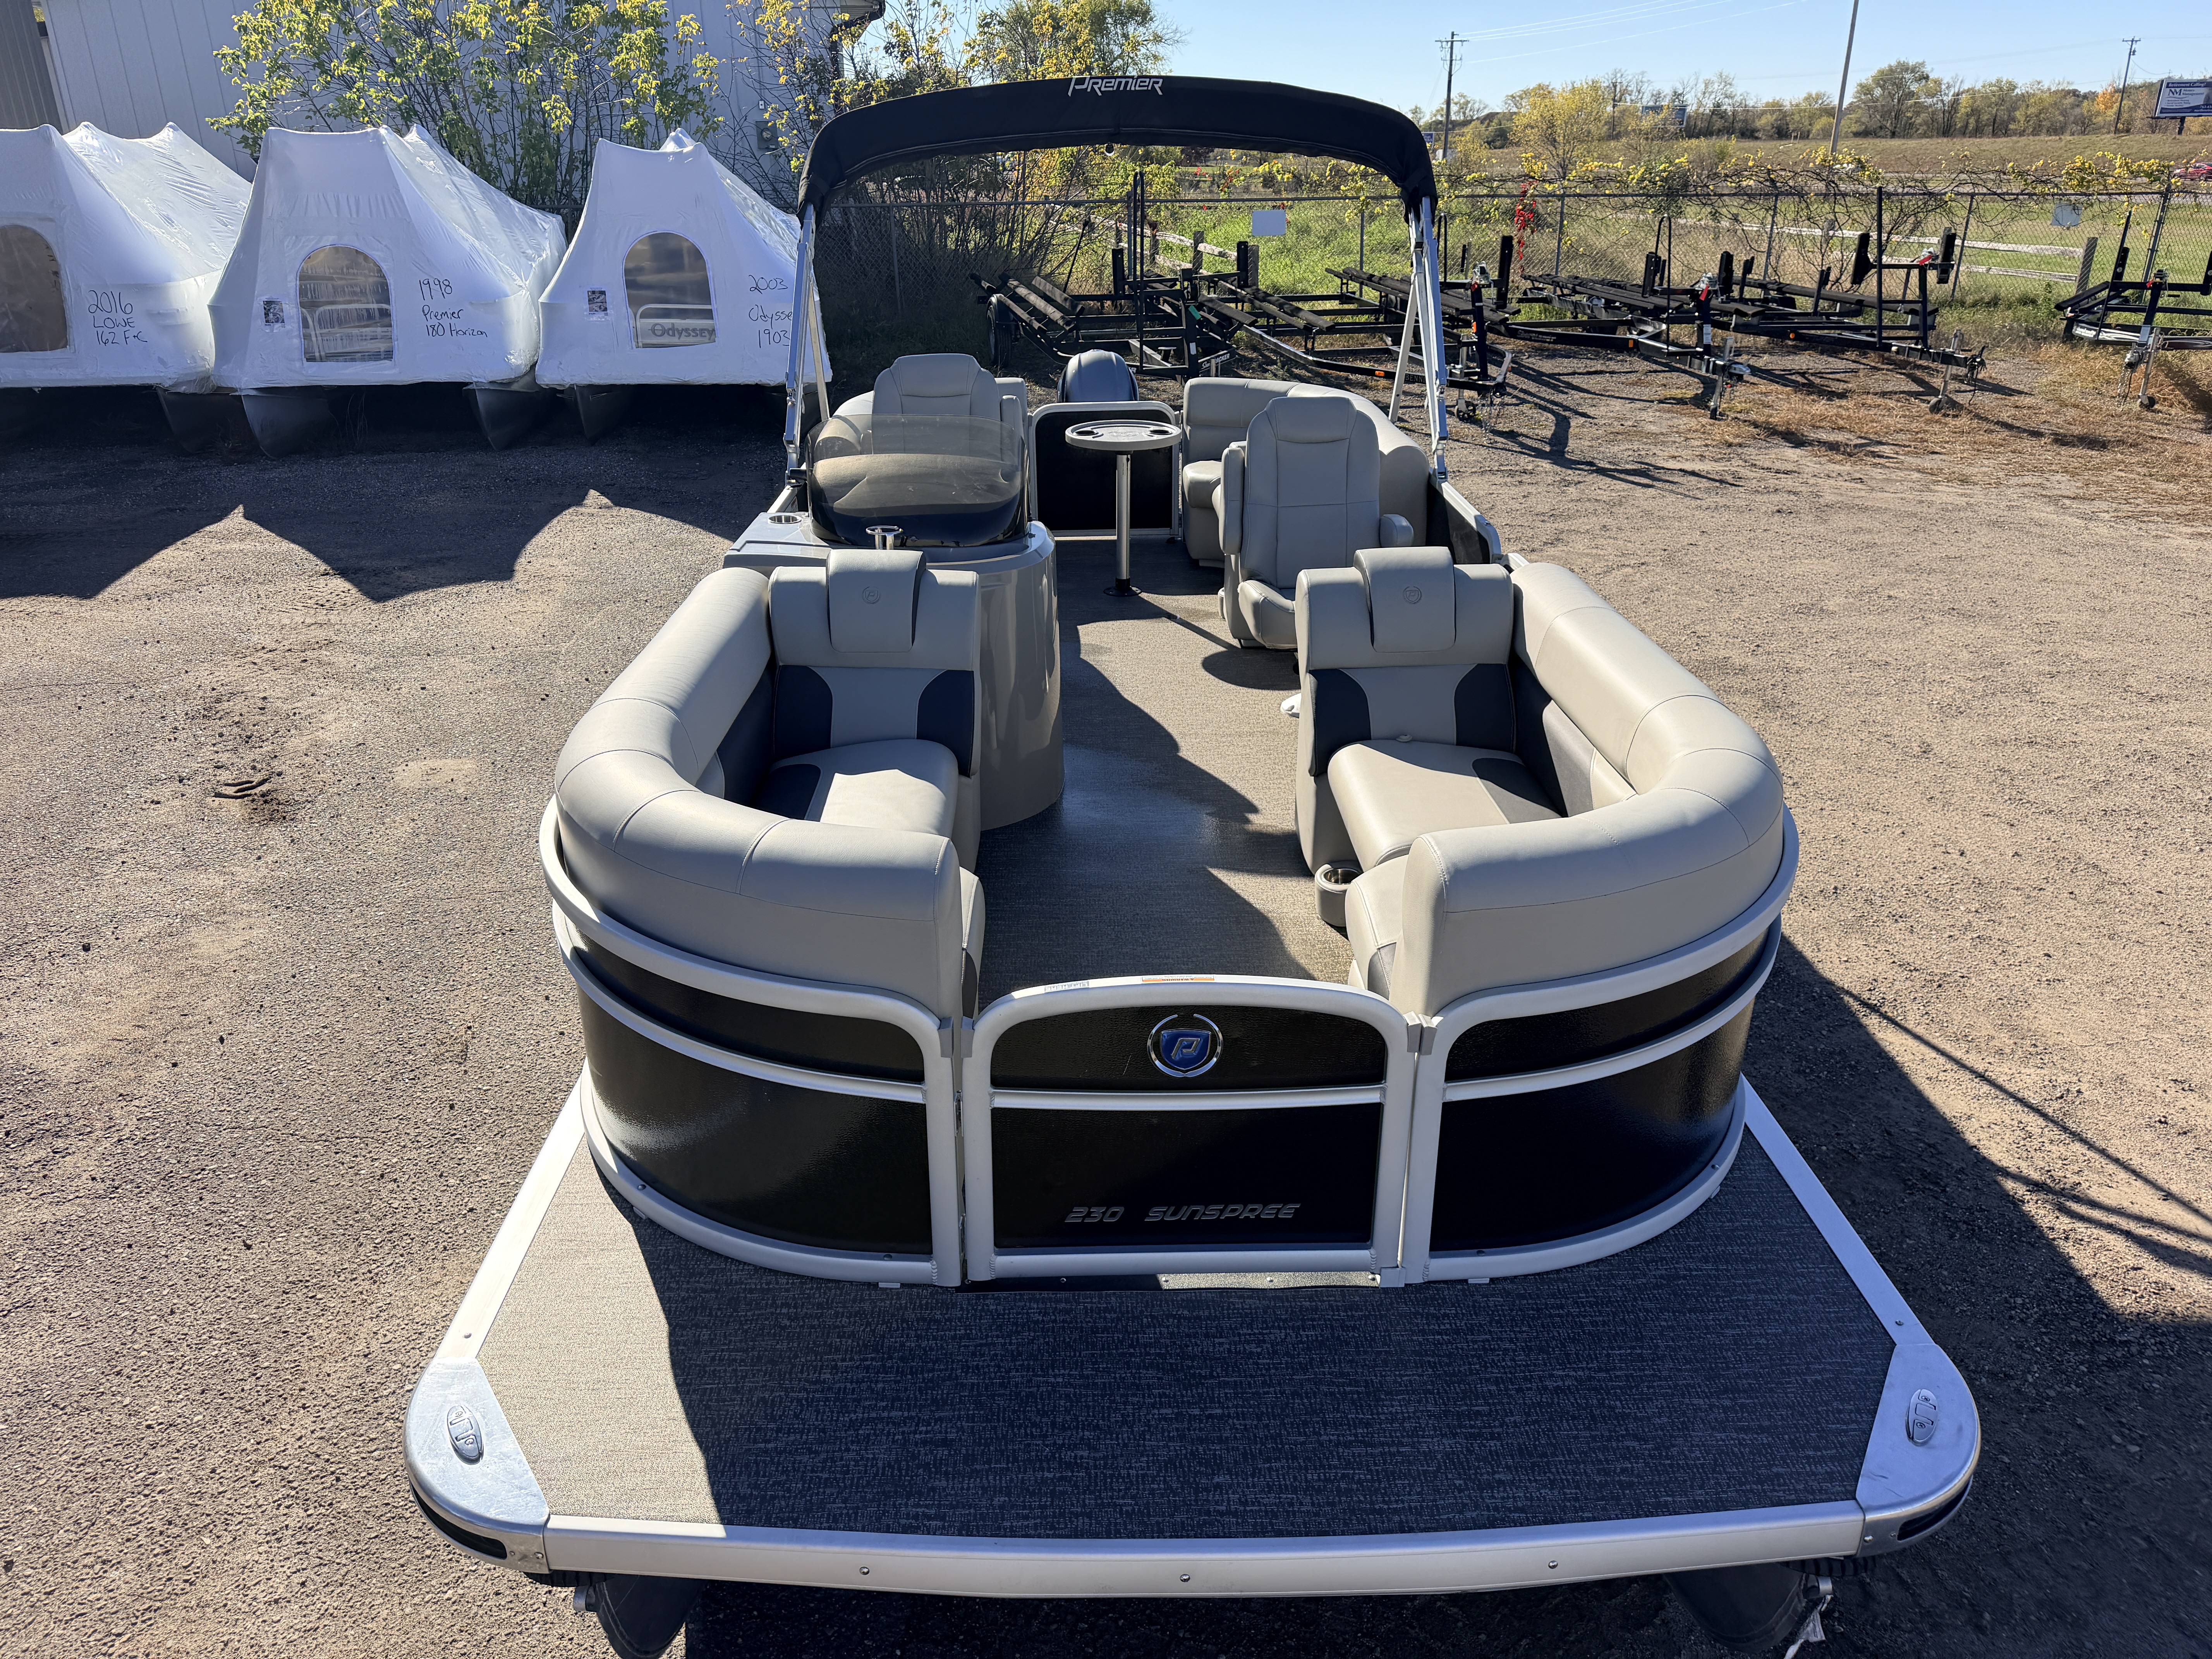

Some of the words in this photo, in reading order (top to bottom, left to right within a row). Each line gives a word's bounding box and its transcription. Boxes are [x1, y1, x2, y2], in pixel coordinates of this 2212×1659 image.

[419, 278, 453, 301] 1998
[749, 275, 788, 295] 2003
[88, 290, 133, 314] 2016
[93, 315, 135, 329] LOWE
[422, 304, 464, 322] Premier
[749, 304, 793, 330] Odysse
[96, 330, 120, 346] 162
[426, 322, 445, 337] 180
[449, 323, 488, 338] Horizon
[1065, 1206, 1124, 1222] 230
